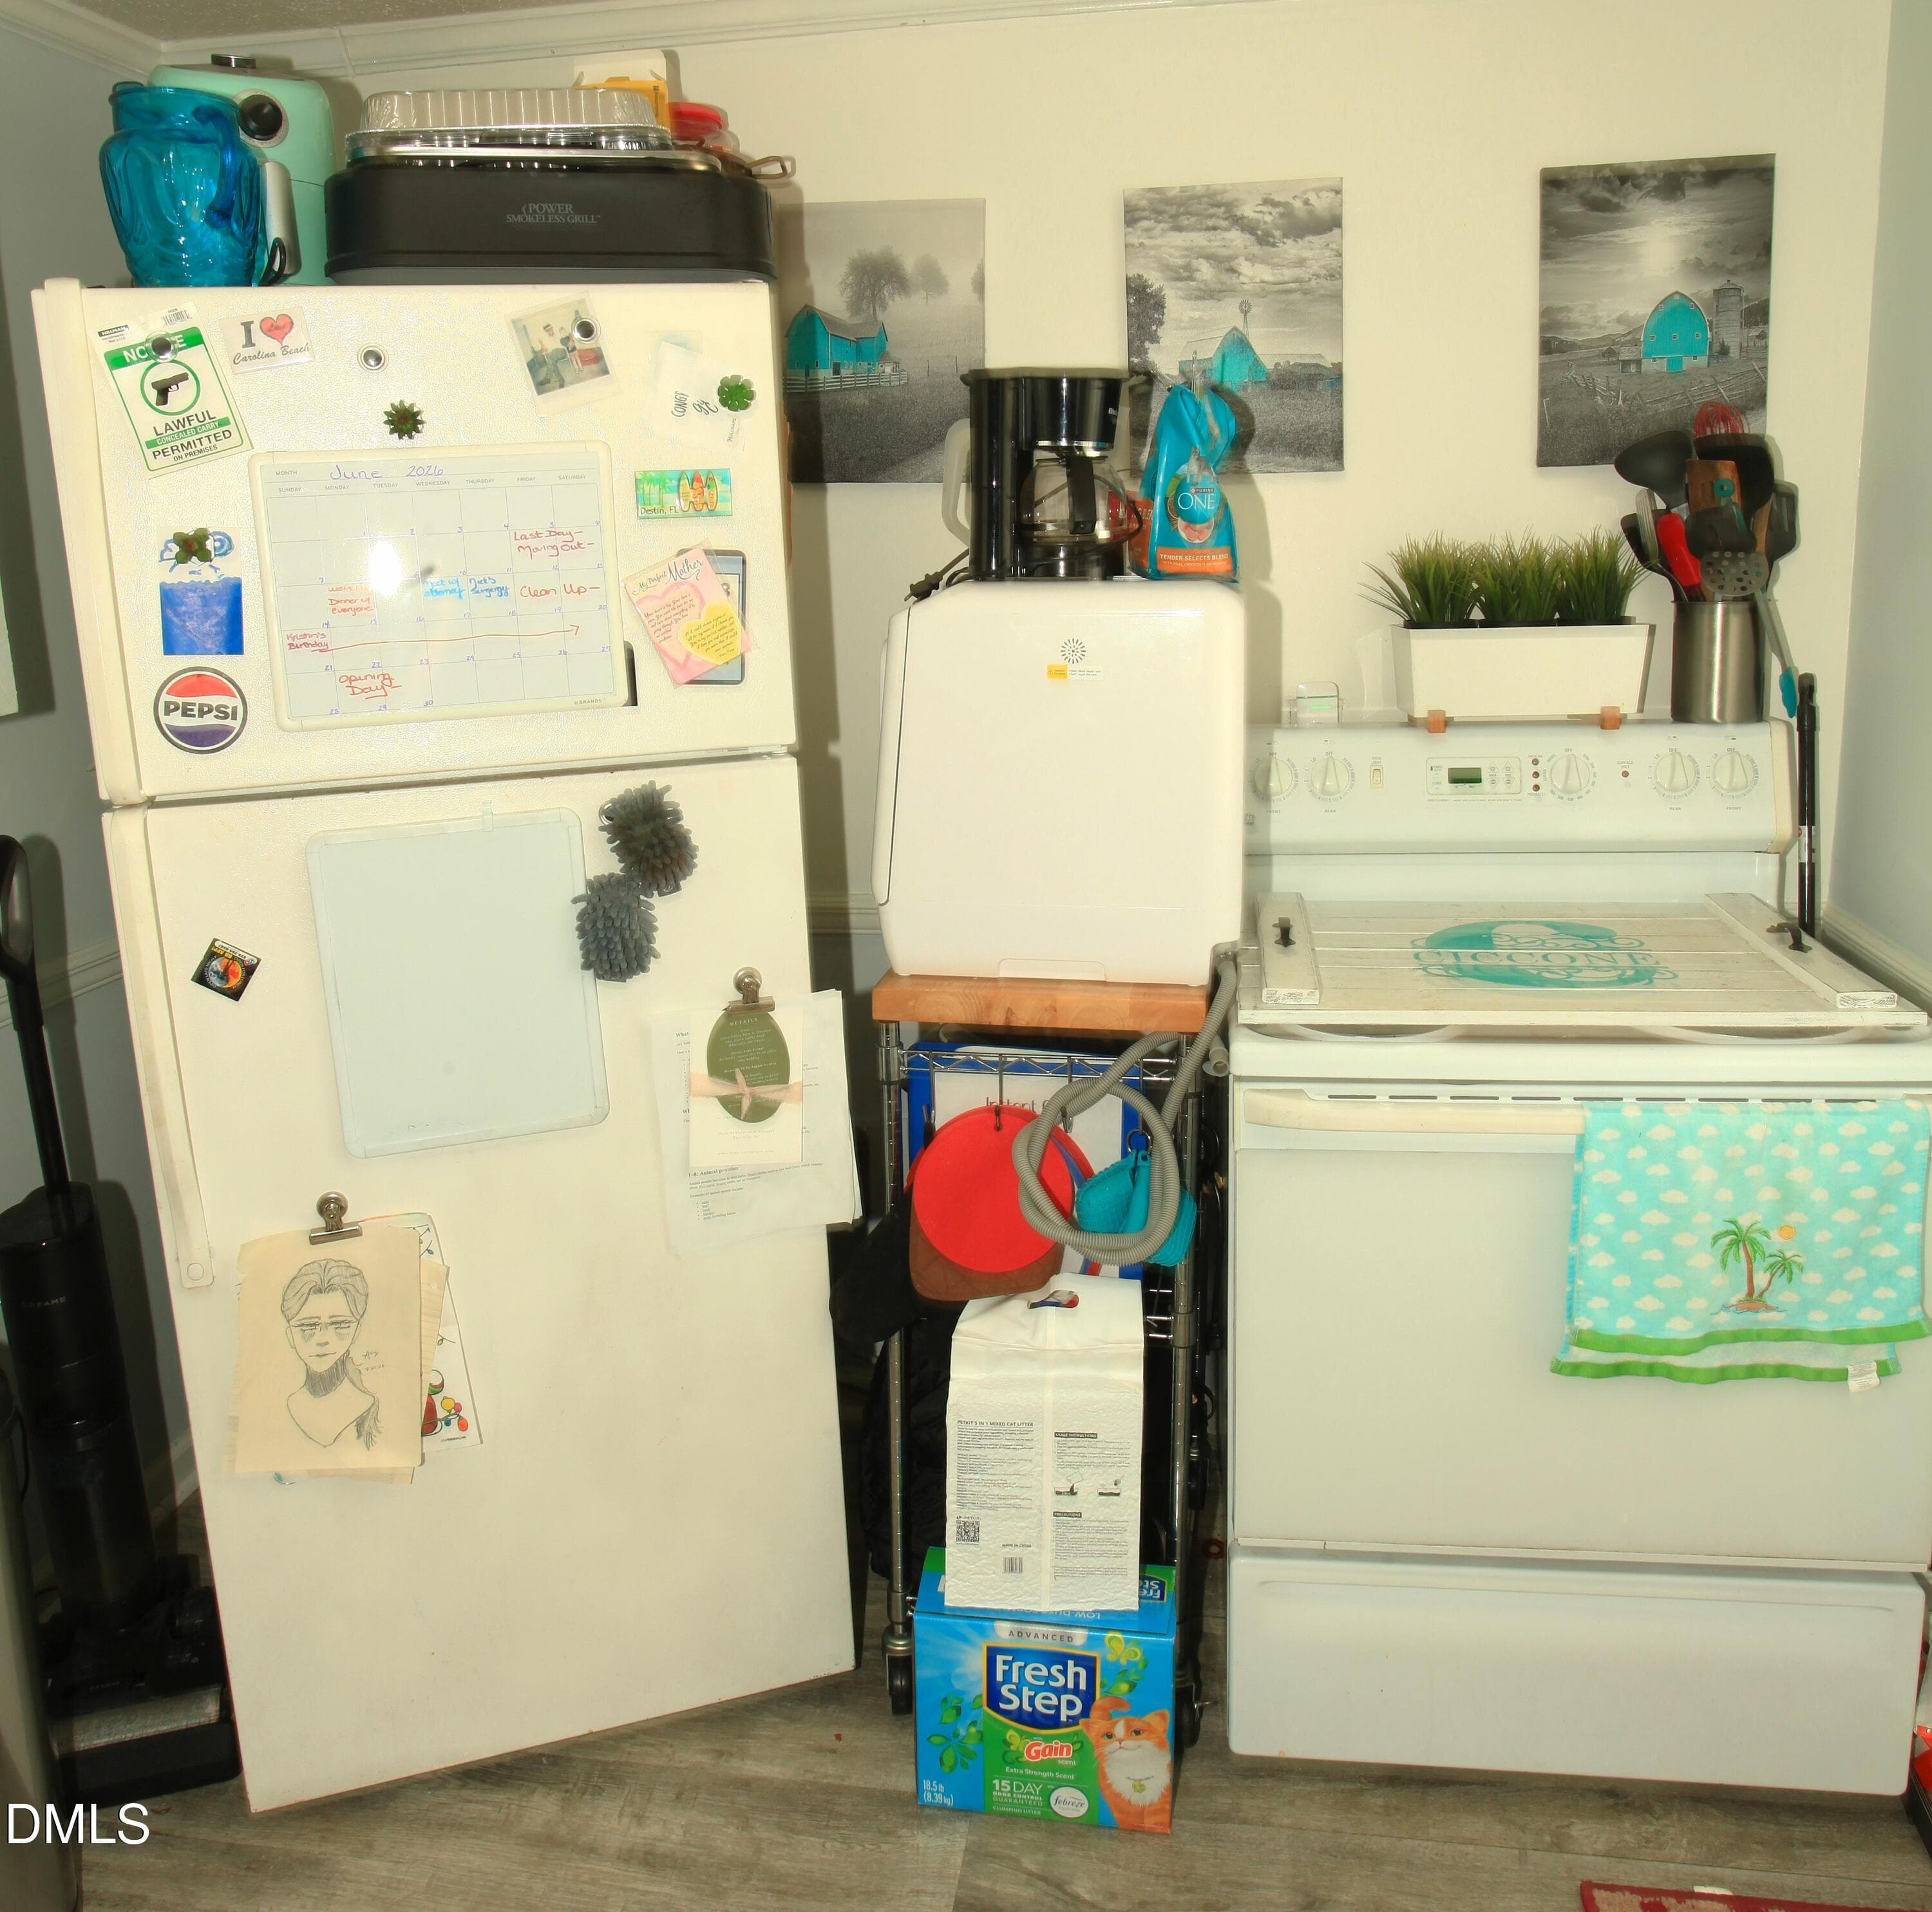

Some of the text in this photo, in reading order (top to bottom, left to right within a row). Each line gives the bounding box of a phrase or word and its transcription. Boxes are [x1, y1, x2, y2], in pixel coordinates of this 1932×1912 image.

[528, 204, 574, 213] POWER
[507, 214, 565, 223] SMOKELESS
[240, 321, 256, 348] I
[122, 334, 187, 363] NOE
[233, 343, 309, 364] Carolina Beach
[153, 410, 216, 436] LAWFUL
[157, 421, 220, 445] CONCEALED CARRY
[153, 430, 232, 459] PERMITTED
[185, 444, 218, 459] PREMISES
[330, 465, 444, 480] June 2026
[1178, 493, 1215, 510] ONE
[514, 531, 543, 541] Last
[665, 558, 704, 585] Mother
[520, 585, 556, 597] Clean
[164, 701, 238, 721] PEPSI
[1412, 951, 1661, 966] CICCONE
[1009, 1630, 1074, 1643] ADVANCED
[995, 1654, 1087, 1691] Fresh
[999, 1684, 1083, 1722] Step
[1025, 1740, 1073, 1761] Gain
[1025, 1768, 1054, 1777] Strength
[923, 1779, 944, 1792] 18.5 lb
[992, 1779, 1043, 1795] 15 DAY
[924, 1790, 953, 1806] (8.39 kg)
[993, 1797, 1043, 1806] GUARANTEED
[1054, 1795, 1085, 1808] febreze
